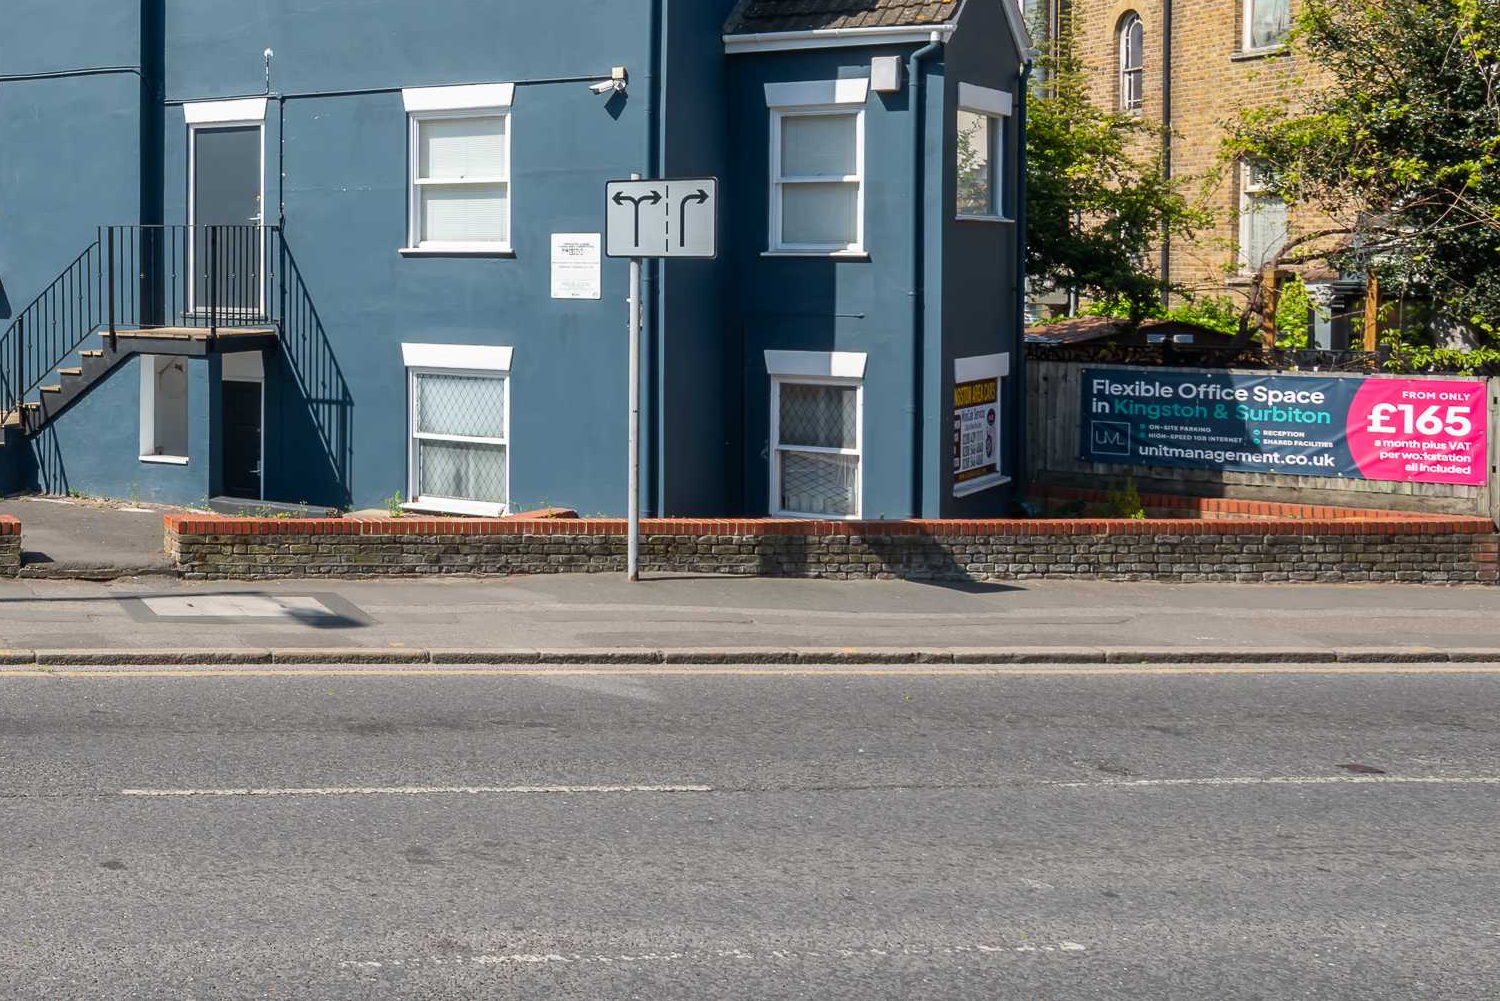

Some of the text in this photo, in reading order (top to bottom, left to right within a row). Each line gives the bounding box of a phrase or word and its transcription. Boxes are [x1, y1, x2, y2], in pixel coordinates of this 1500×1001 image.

[1092, 379, 1325, 406] Flexible Office Space
[1402, 390, 1471, 401] FROM ONLY
[1092, 398, 1331, 424] in Kingston & Surbiton
[1366, 402, 1472, 437] £165
[1148, 424, 1212, 433] ON-SITE PARKING
[1262, 429, 1305, 438] RECEPTION
[1148, 432, 1193, 441] HIGH-SPEED
[1207, 435, 1243, 444] INTERNET
[1262, 439, 1334, 448] SHARED FACILITIES
[1374, 439, 1472, 451] a month plus VAT
[1139, 444, 1336, 468] unitmanagement.co.uk
[1379, 451, 1472, 463] per workstation
[1404, 462, 1418, 472] all
